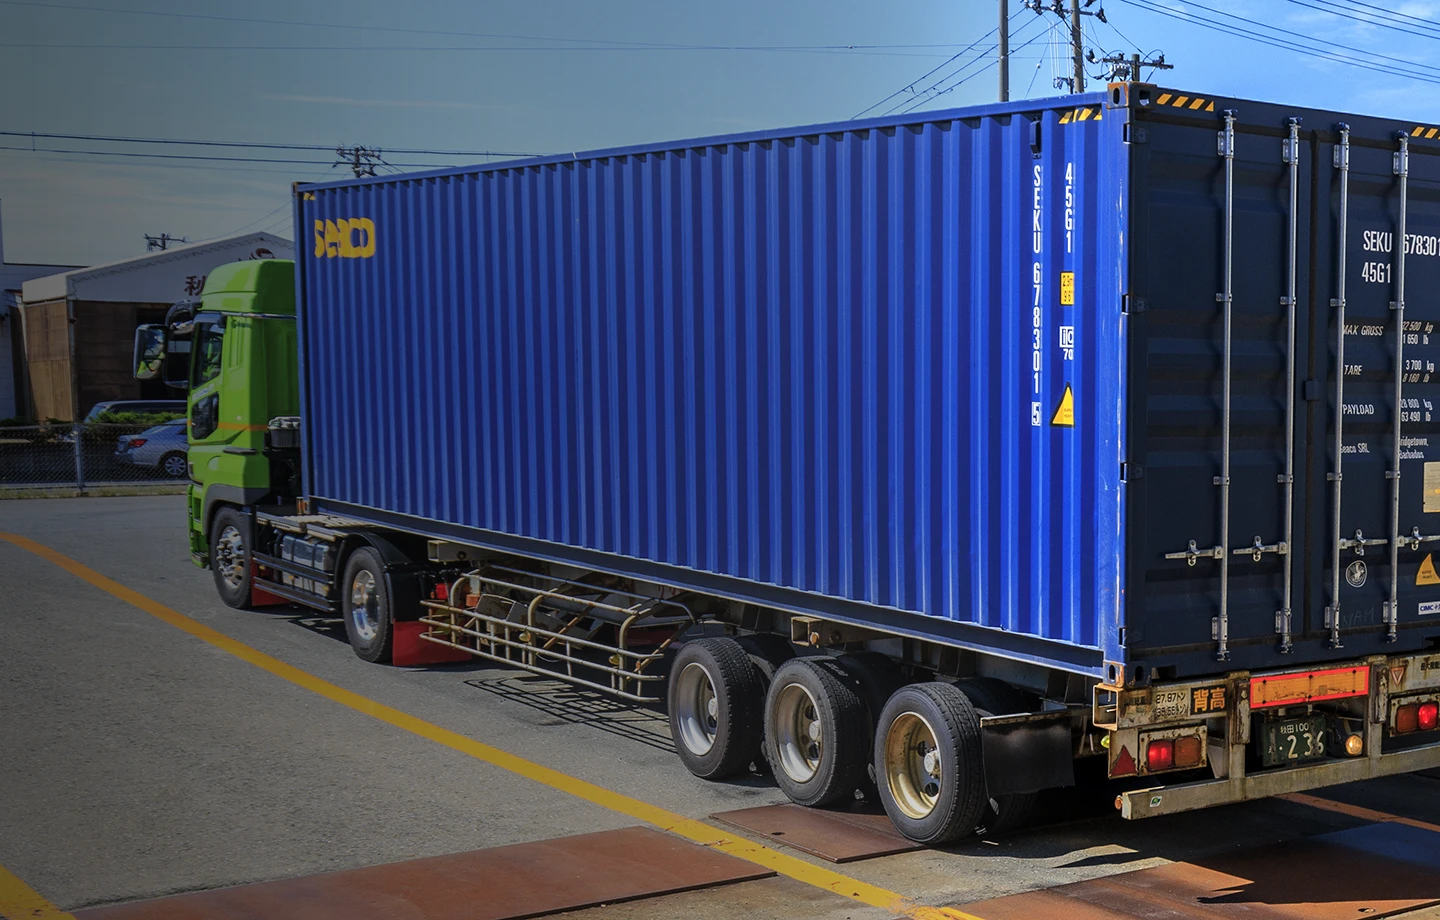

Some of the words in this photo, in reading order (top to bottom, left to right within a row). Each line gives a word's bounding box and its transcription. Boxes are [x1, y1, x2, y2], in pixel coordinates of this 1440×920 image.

[1032, 164, 1041, 254] SEKU
[1064, 162, 1073, 254] 45G1
[1363, 230, 1393, 253] SEKU
[1361, 261, 1391, 284] 45G1
[1032, 261, 1041, 394] 678301
[1360, 325, 1384, 337] GROSS
[1424, 322, 1434, 334] kg
[1344, 364, 1362, 376] TARE
[1426, 360, 1435, 373] kg
[1342, 404, 1375, 415] PAYLOAD
[1423, 399, 1433, 411] kg
[1425, 412, 1432, 422] lb
[1357, 442, 1370, 454] SRL
[1400, 435, 1429, 449] ridgetown,
[1193, 687, 1226, 713] 背高
